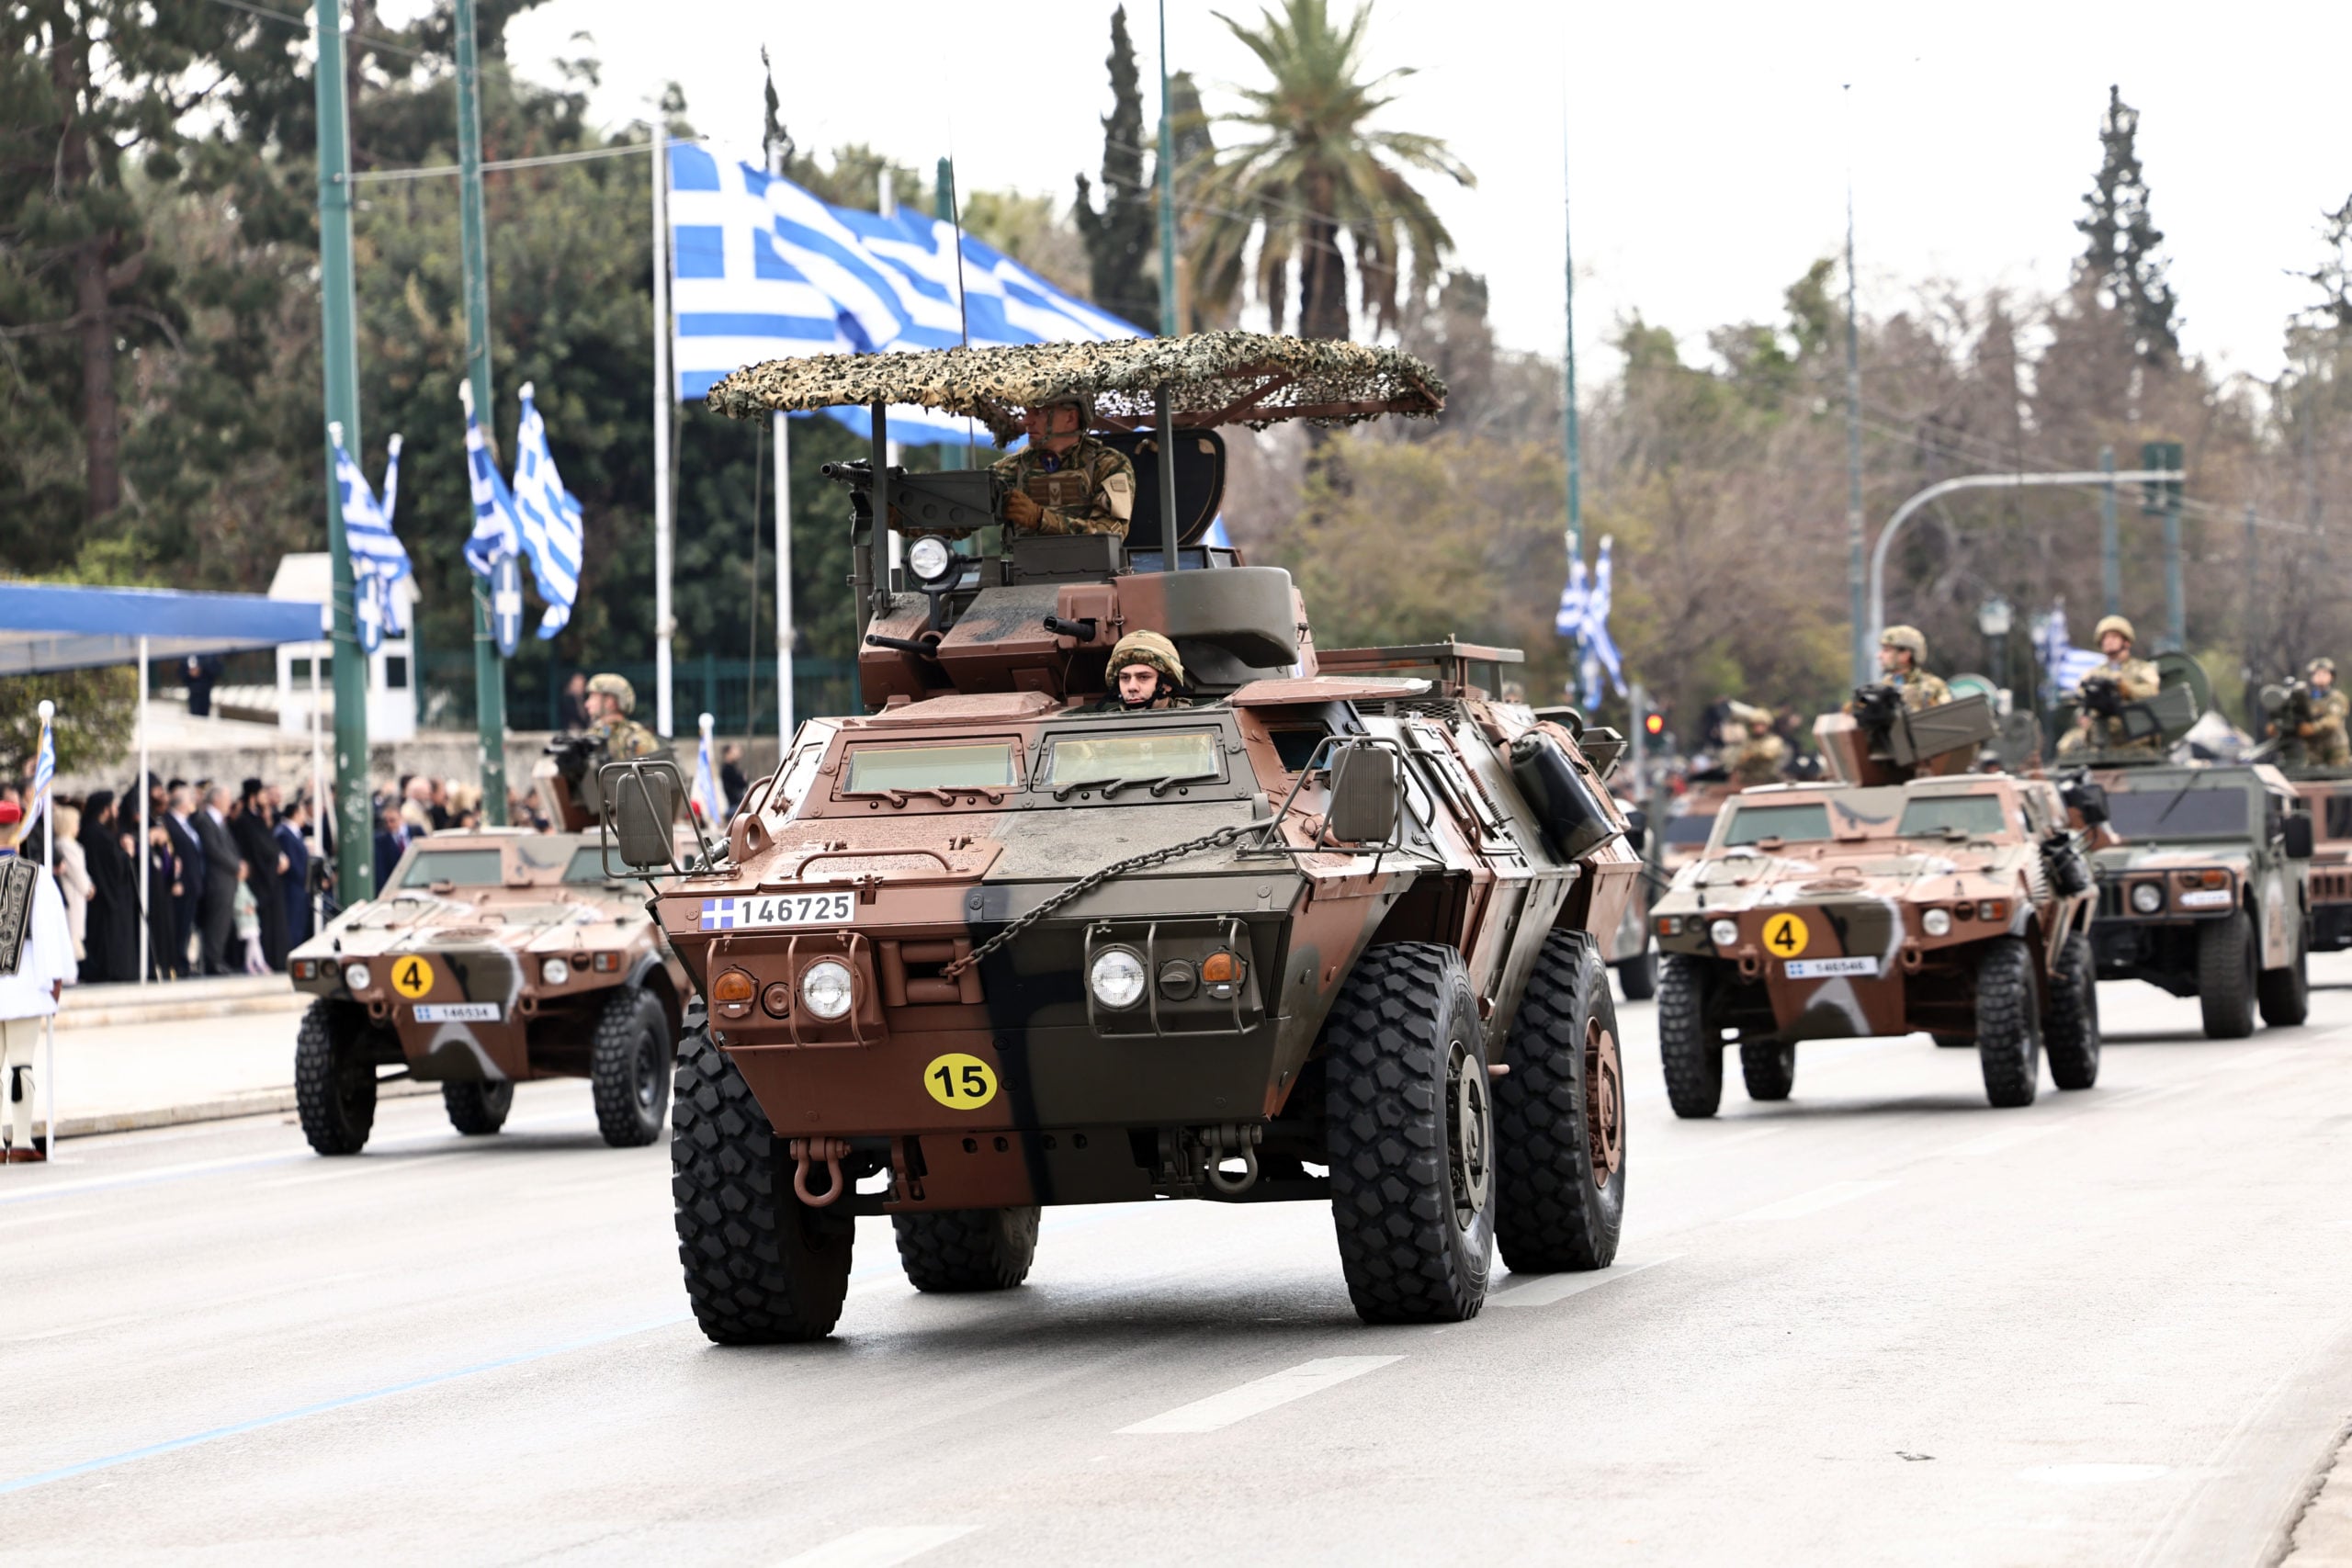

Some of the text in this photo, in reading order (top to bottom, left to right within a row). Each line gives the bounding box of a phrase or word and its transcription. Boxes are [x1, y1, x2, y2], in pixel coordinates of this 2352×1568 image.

[742, 896, 849, 924] 146725
[1774, 919, 1796, 951] 4
[401, 961, 423, 991] 4
[933, 1066, 988, 1098] 15
